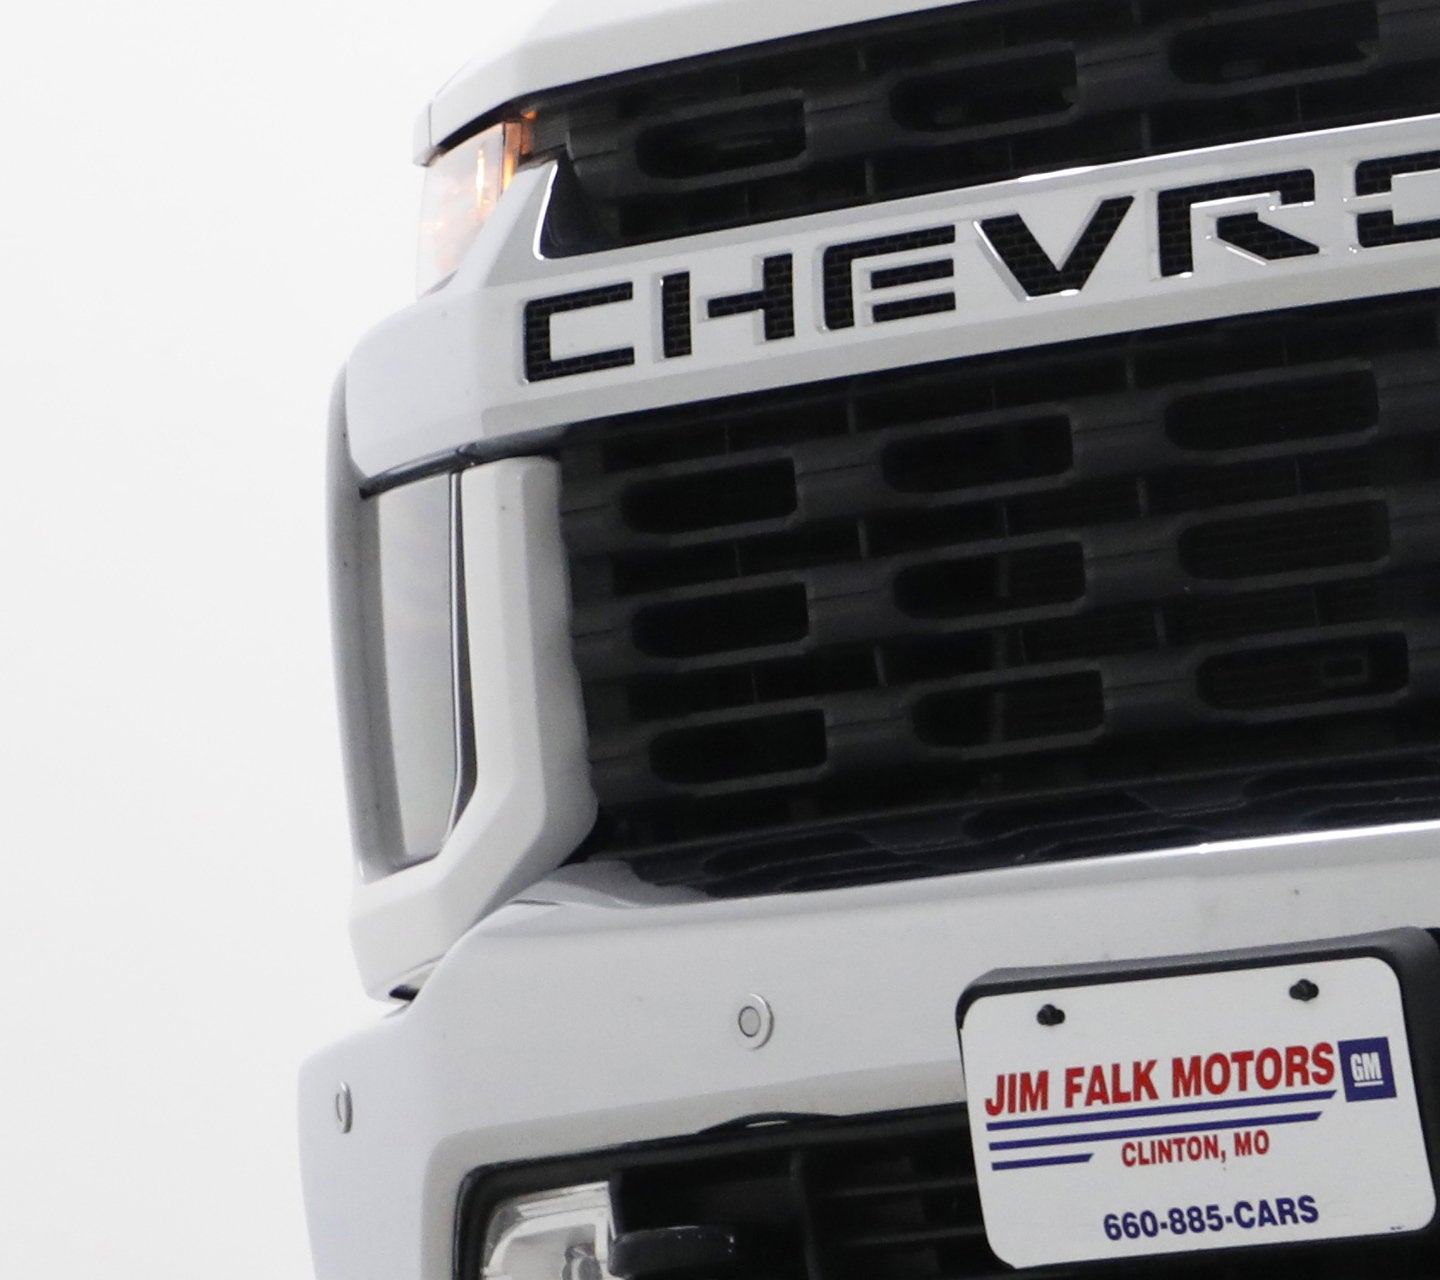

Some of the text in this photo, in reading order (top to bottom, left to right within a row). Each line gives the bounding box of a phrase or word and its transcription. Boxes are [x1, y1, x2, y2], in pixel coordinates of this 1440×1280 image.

[985, 1042, 1336, 1117] JIM FALK MOTORS
[1350, 1051, 1382, 1082] GM
[1122, 1129, 1270, 1167] CLINTON, MO
[1104, 1195, 1318, 1241] 660-885-CARS
